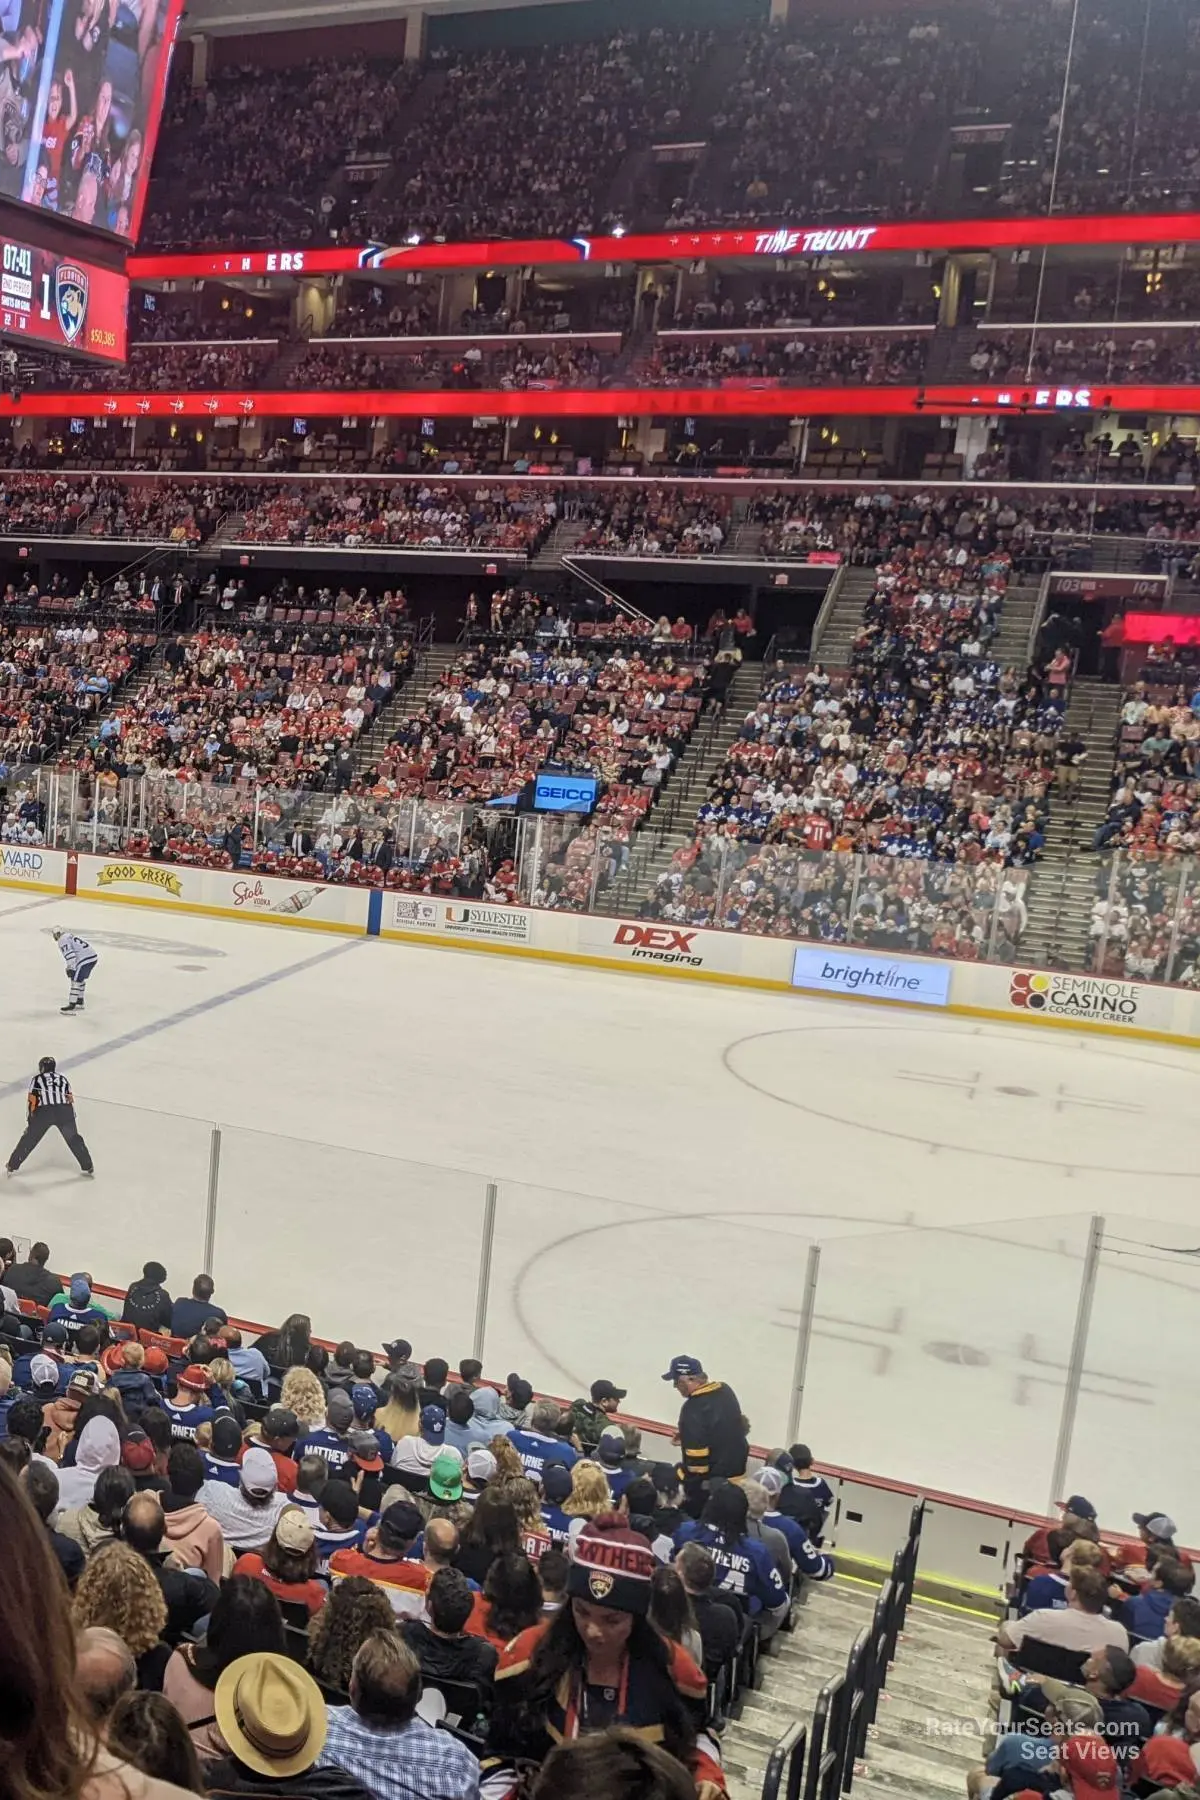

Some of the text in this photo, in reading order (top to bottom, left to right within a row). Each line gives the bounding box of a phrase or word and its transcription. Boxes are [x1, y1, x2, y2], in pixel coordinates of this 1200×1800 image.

[3, 243, 32, 276] 07:41
[60, 269, 85, 287] FLORIDA
[40, 273, 51, 320] 1
[90, 328, 116, 346] $50,385
[1056, 579, 1159, 594] 103 104
[536, 786, 593, 801] GEICO
[3, 866, 42, 879] COUNTY
[106, 867, 175, 887] GOOD GREEK
[232, 880, 264, 906] Stoli
[470, 909, 527, 927] SYLVESTER
[613, 924, 697, 954] DEX
[631, 947, 704, 966] imaging
[821, 962, 920, 991] brightline
[1052, 976, 1141, 1000] SEMINOLE
[1050, 990, 1137, 1015] CASINO
[1048, 1004, 1135, 1024] COCONUT CREEK
[171, 1423, 198, 1443] RNER
[304, 1444, 349, 1464] MATTHEW
[518, 1453, 545, 1471] ARNE
